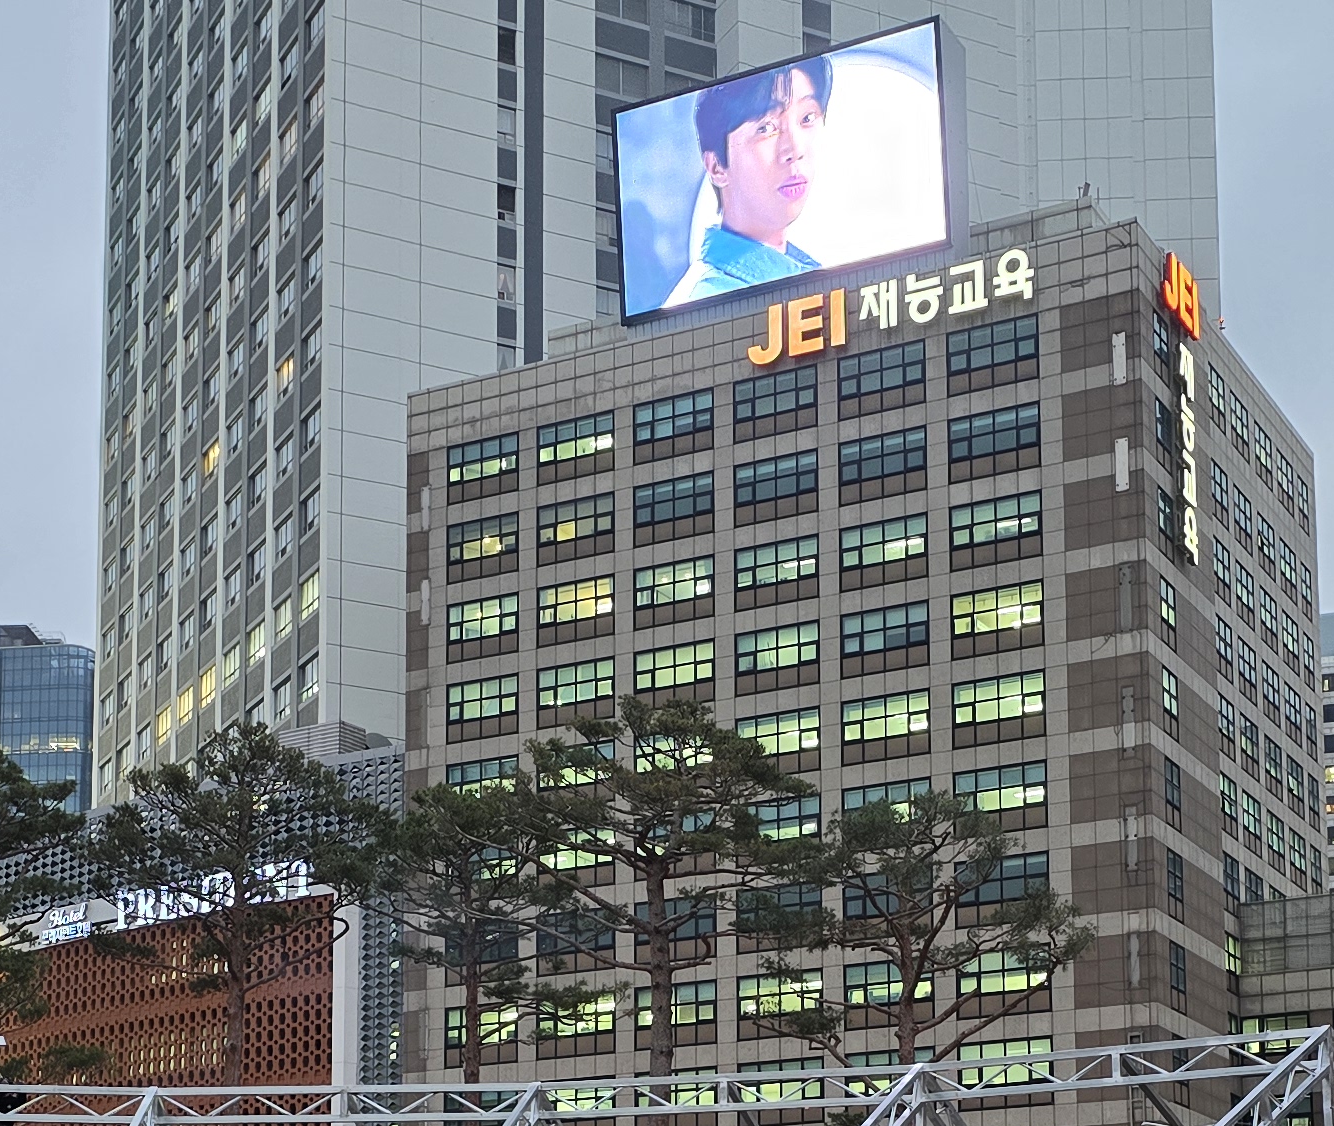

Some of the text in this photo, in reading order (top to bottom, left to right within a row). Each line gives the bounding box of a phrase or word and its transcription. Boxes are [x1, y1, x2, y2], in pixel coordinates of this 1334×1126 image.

[747, 248, 1035, 366] JEI 재능교육
[1163, 251, 1201, 341] JEI
[47, 902, 88, 929] Hotel
